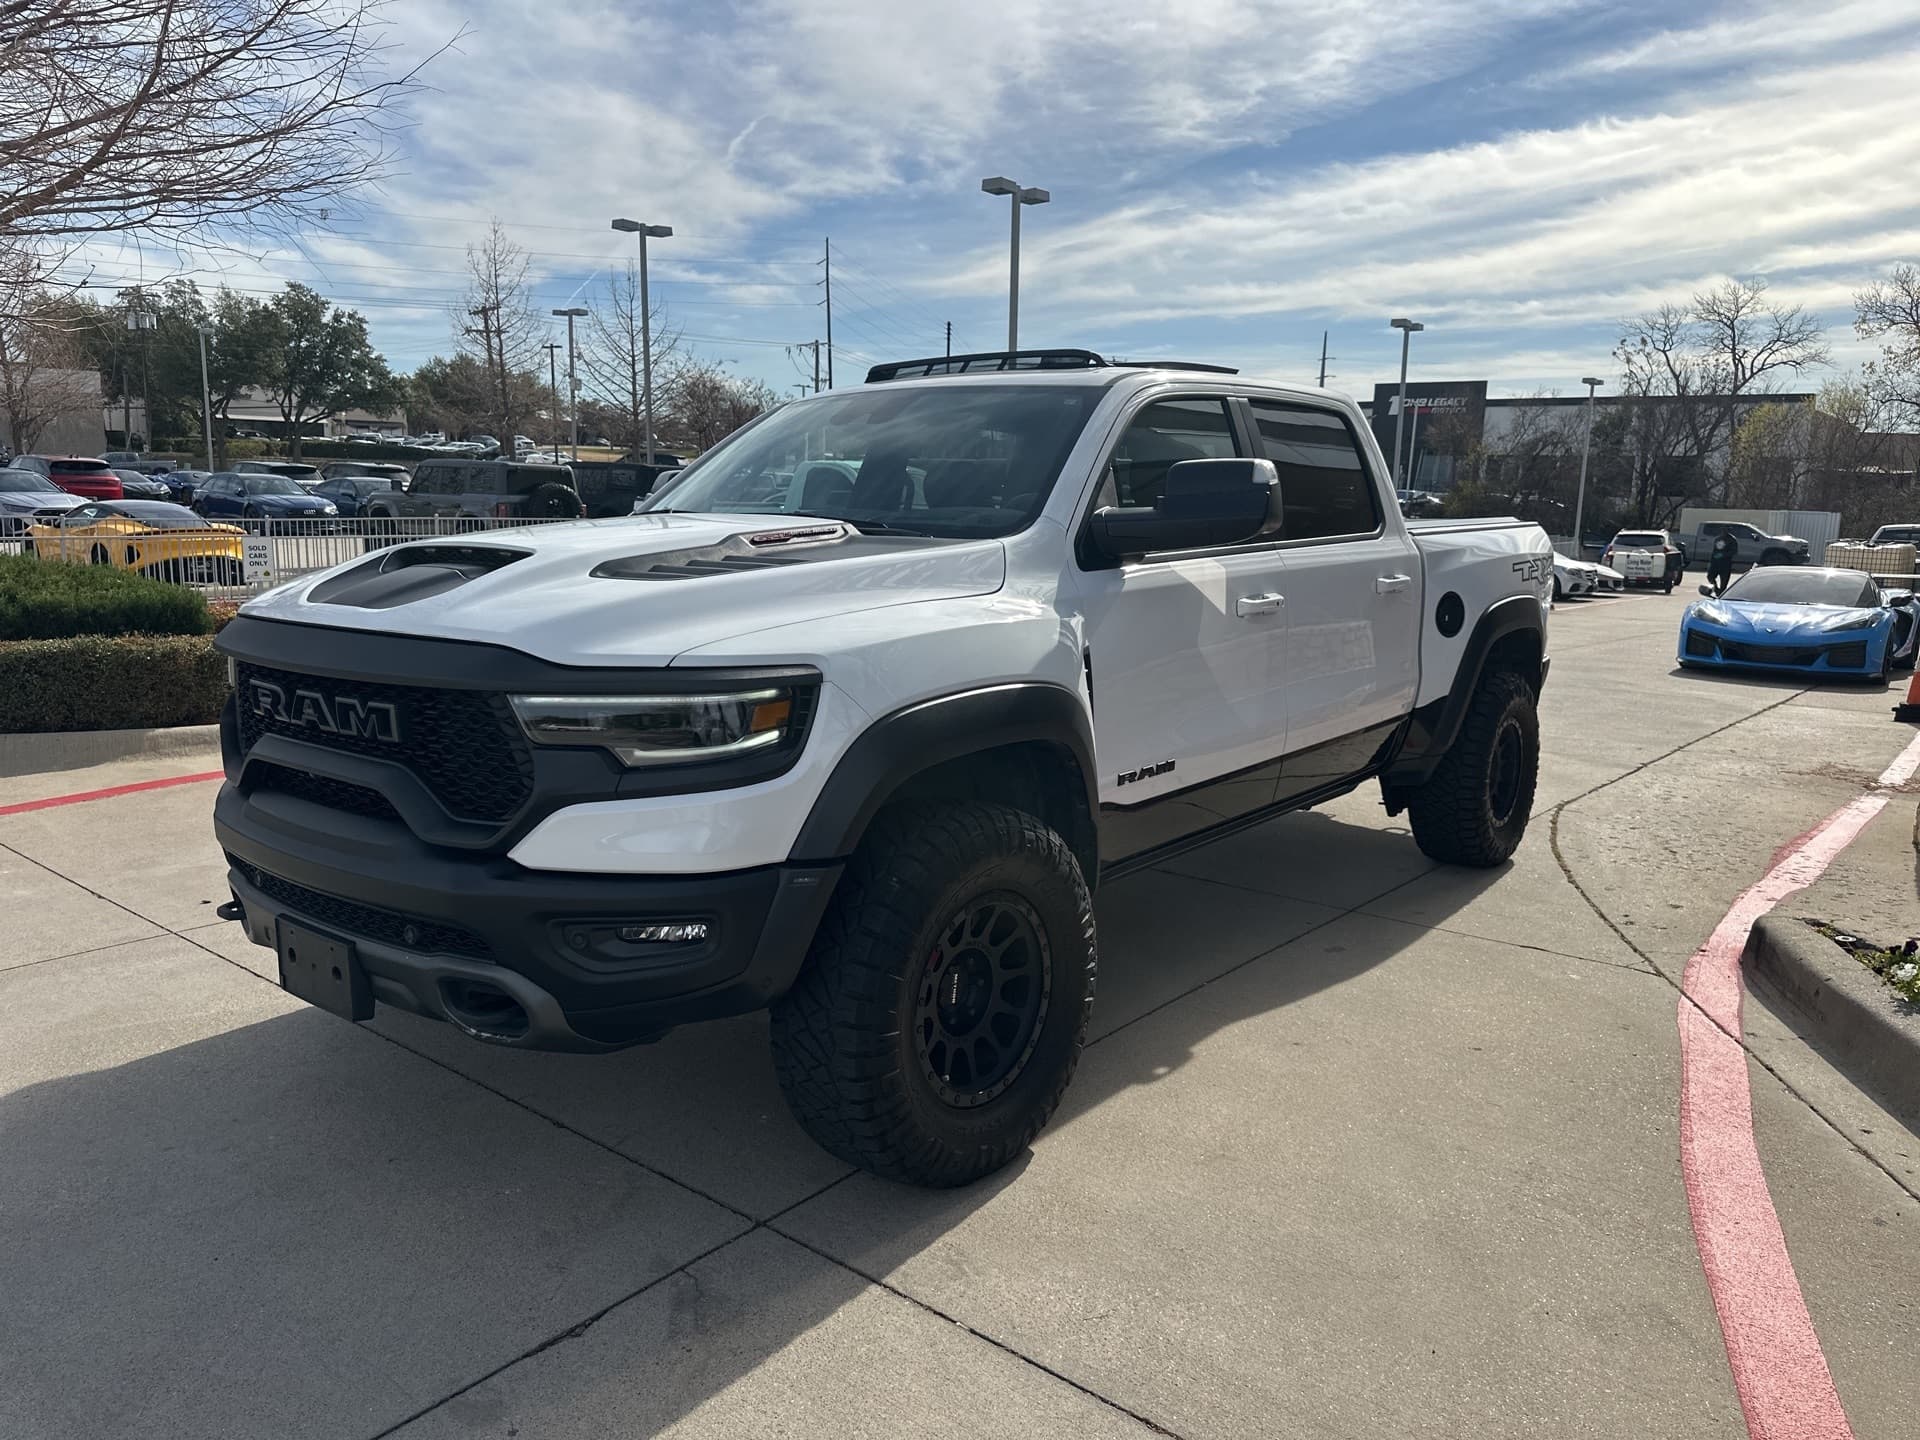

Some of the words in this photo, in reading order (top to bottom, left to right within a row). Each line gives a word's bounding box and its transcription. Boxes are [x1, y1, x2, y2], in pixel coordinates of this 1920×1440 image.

[1427, 397, 1467, 406] LEGACY
[1512, 556, 1553, 584] TRX
[249, 679, 399, 742] RAM
[1117, 758, 1176, 786] RAM
